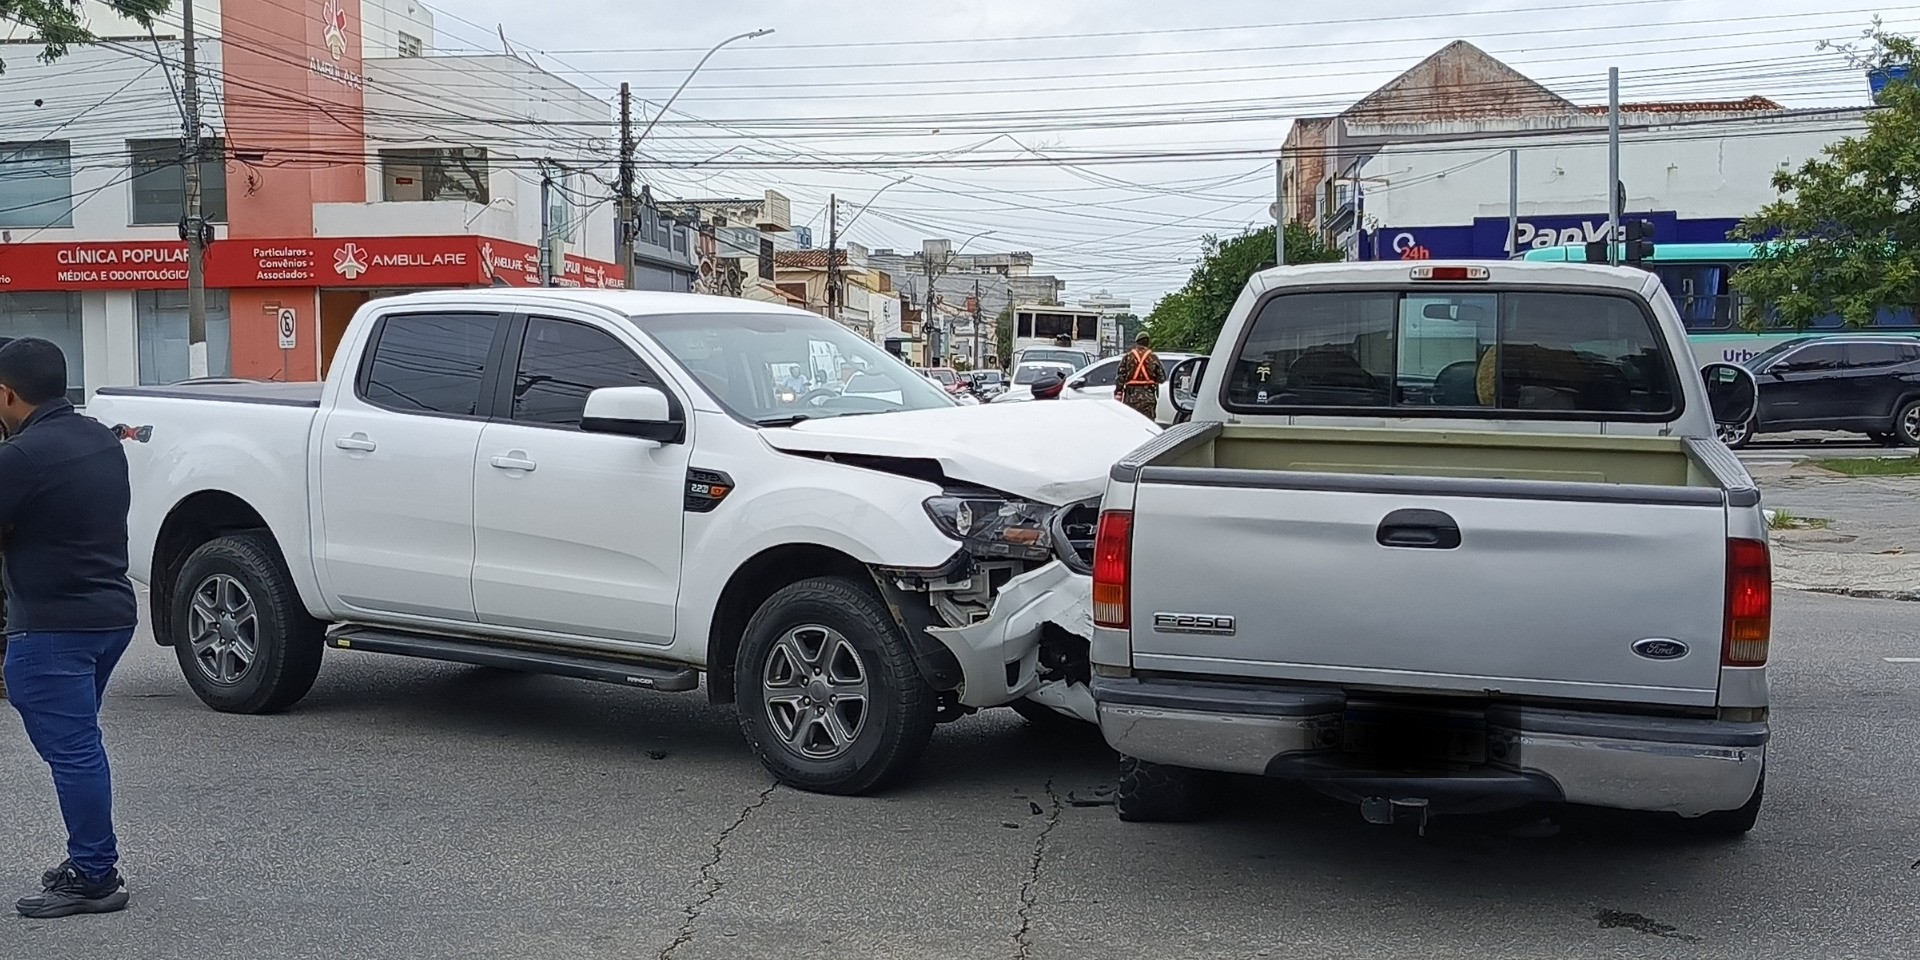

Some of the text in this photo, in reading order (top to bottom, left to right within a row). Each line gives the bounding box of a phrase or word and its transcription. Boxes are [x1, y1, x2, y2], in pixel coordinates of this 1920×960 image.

[57, 246, 119, 264] CLÍNICA
[253, 247, 307, 257] Particulares
[1401, 245, 1429, 260] 24h
[259, 257, 307, 268] Convênios
[371, 253, 467, 266] AMBULARE
[57, 269, 99, 281] MÉDICA
[100, 270, 107, 281] E
[256, 269, 308, 280] Associados
[1646, 642, 1675, 655] Ford
